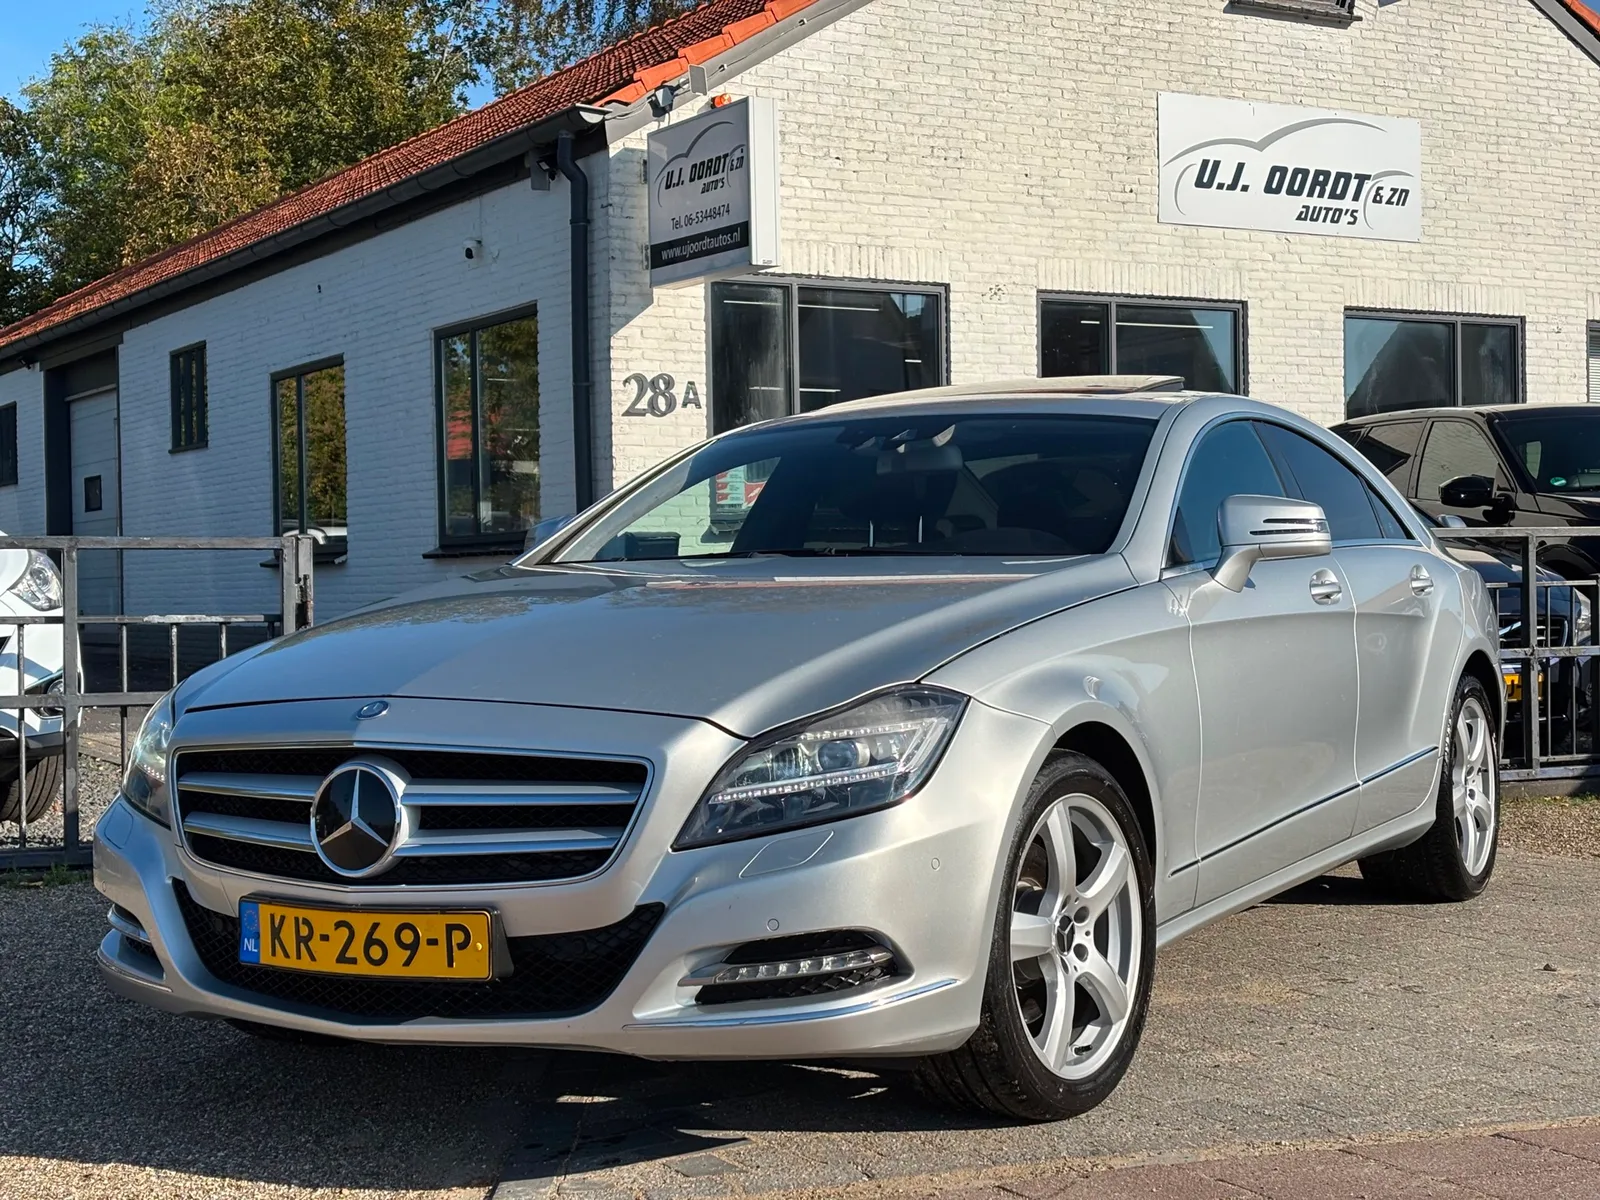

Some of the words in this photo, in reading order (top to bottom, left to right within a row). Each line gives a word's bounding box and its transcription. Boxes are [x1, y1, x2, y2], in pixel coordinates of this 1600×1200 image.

[664, 167, 684, 190] U.J.
[688, 153, 729, 182] OORDT
[1194, 158, 1250, 193] U.J.
[1263, 165, 1373, 202] OORDT
[1372, 185, 1384, 205] &
[671, 217, 684, 231] Tel.
[683, 203, 730, 228] 06-53448474
[1295, 205, 1359, 225] AUTO'S
[661, 227, 740, 259] www.ujoordtautos.nl
[621, 373, 676, 417] 28
[681, 381, 702, 409] A
[244, 938, 258, 952] NL
[269, 913, 473, 968] KR-269-P
